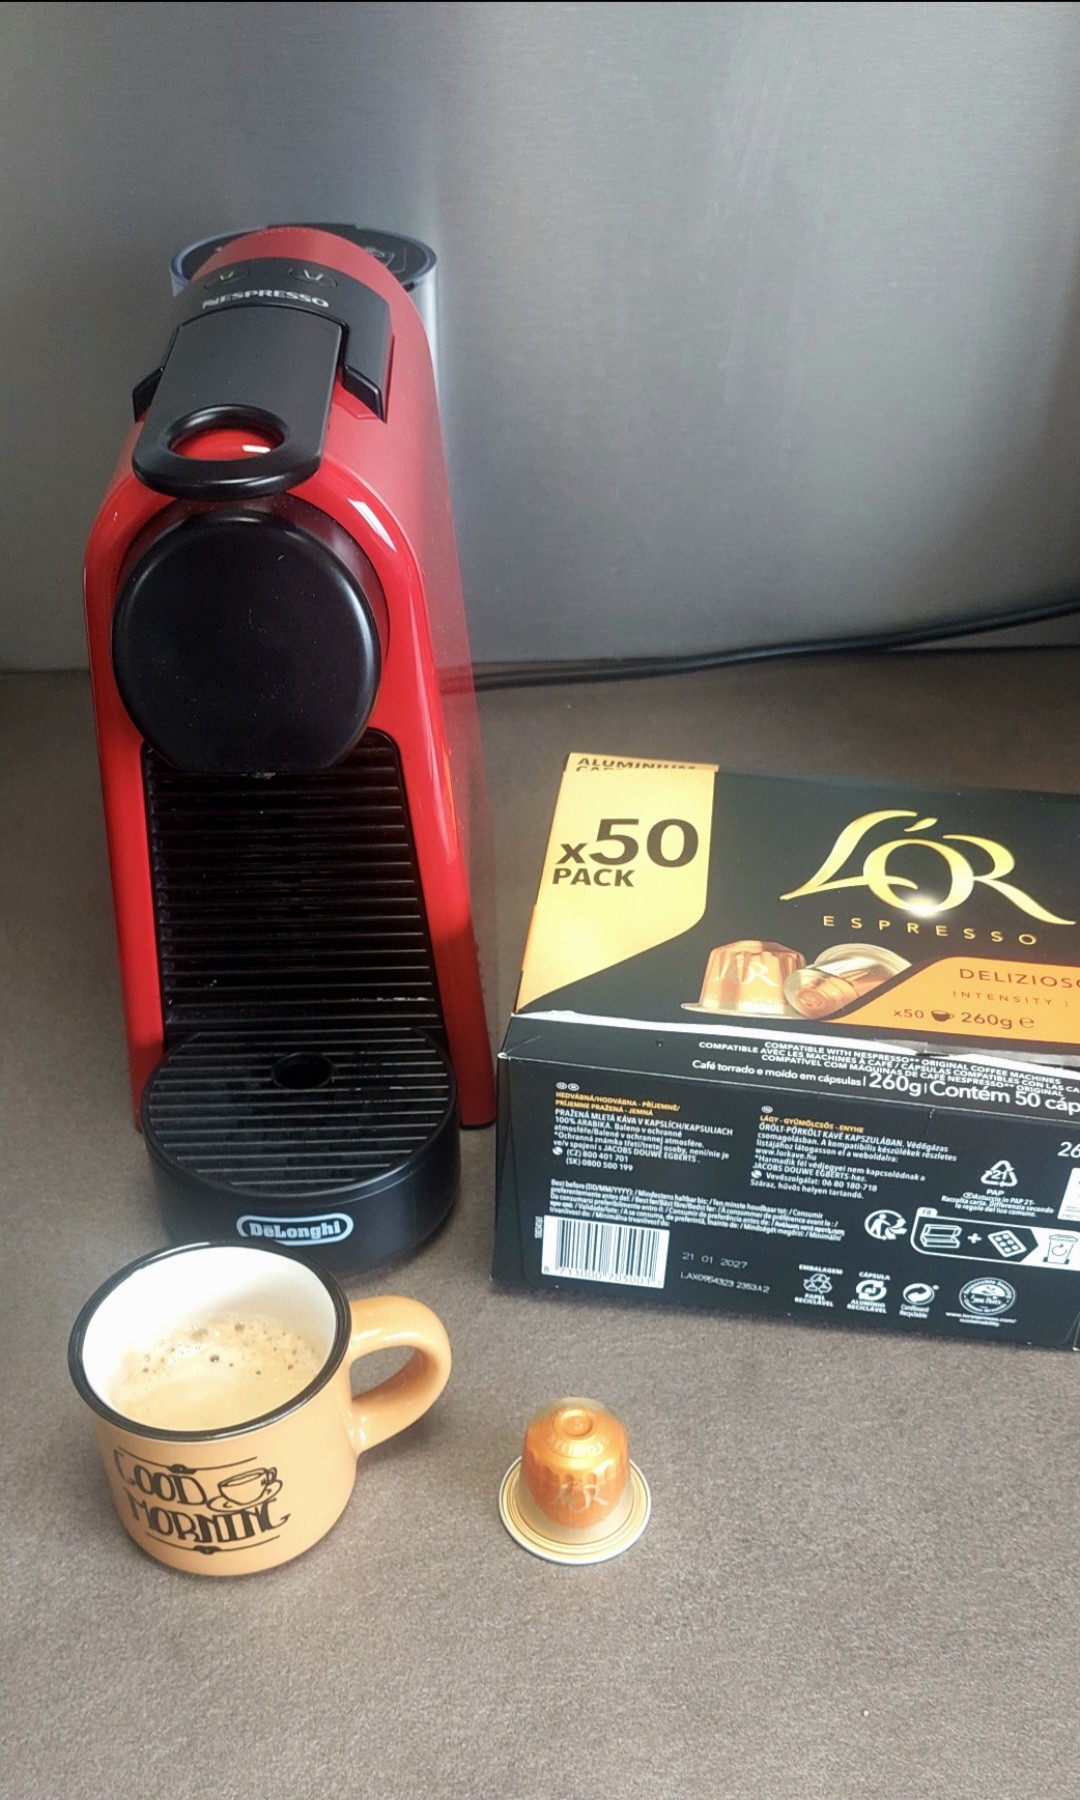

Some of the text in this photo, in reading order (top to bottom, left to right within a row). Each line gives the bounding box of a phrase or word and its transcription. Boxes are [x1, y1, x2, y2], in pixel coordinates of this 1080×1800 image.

[202, 289, 329, 309] NESPRESSO
[556, 818, 699, 868] x50
[552, 868, 635, 887] PACK
[823, 915, 1037, 945] ESPRESSO
[959, 968, 1080, 988] DELIZIOS
[953, 990, 1052, 1006] INTENSITY
[893, 1009, 924, 1019] x50
[961, 1011, 1012, 1030] 260g
[698, 1041, 758, 1054] COMPATIBLE
[760, 1048, 786, 1056] AVEC
[805, 1053, 857, 1064] MACHINES
[868, 1060, 893, 1068] CAFÉ
[900, 1064, 952, 1075] CÁPSULAS
[953, 1070, 1020, 1085] COMPATIBLES
[1021, 1080, 1044, 1088] CON
[1045, 1083, 1064, 1091] LAS
[765, 1042, 824, 1055] COMPATIBLE
[826, 1049, 852, 1058] WITH
[921, 1060, 969, 1071] ORIGINAL
[970, 1066, 1008, 1077] COFFEE
[1009, 1071, 1062, 1085] MACHINES
[692, 1060, 716, 1070] Café
[717, 1063, 755, 1075] torrado
[765, 1068, 798, 1079] moído
[799, 1073, 816, 1081] em
[818, 1074, 862, 1087] cápsulas
[868, 1072, 921, 1097] 260g
[929, 1079, 1010, 1103] Contém
[1015, 1091, 1041, 1107] 50
[761, 1055, 822, 1067] COMPATÍVEL
[849, 1064, 903, 1076] MÁQUINAS
[919, 1073, 946, 1081] CAFÉ
[1016, 1085, 1064, 1097] ORIGINAL
[554, 1108, 590, 1119] PRAŽENÁ
[591, 1113, 615, 1122] MLETÁ
[616, 1116, 637, 1125] KÁVA
[827, 1140, 876, 1153] kompatibilis
[565, 1157, 633, 1171] (SK) 0800 500 199
[566, 1149, 628, 1163] (CZ) 800 401 701
[752, 1162, 783, 1172] JACOBS
[784, 1166, 814, 1176] DOUWE
[801, 1185, 828, 1196] helyen
[821, 1179, 832, 1187] 06
[833, 1180, 844, 1188] 80
[846, 1182, 878, 1193] 180-718
[985, 1188, 1004, 1196] PAP
[682, 1252, 748, 1268] 21 01 2027
[798, 1263, 843, 1274] EMBALAGEM
[858, 1271, 890, 1280] CÁPSULA
